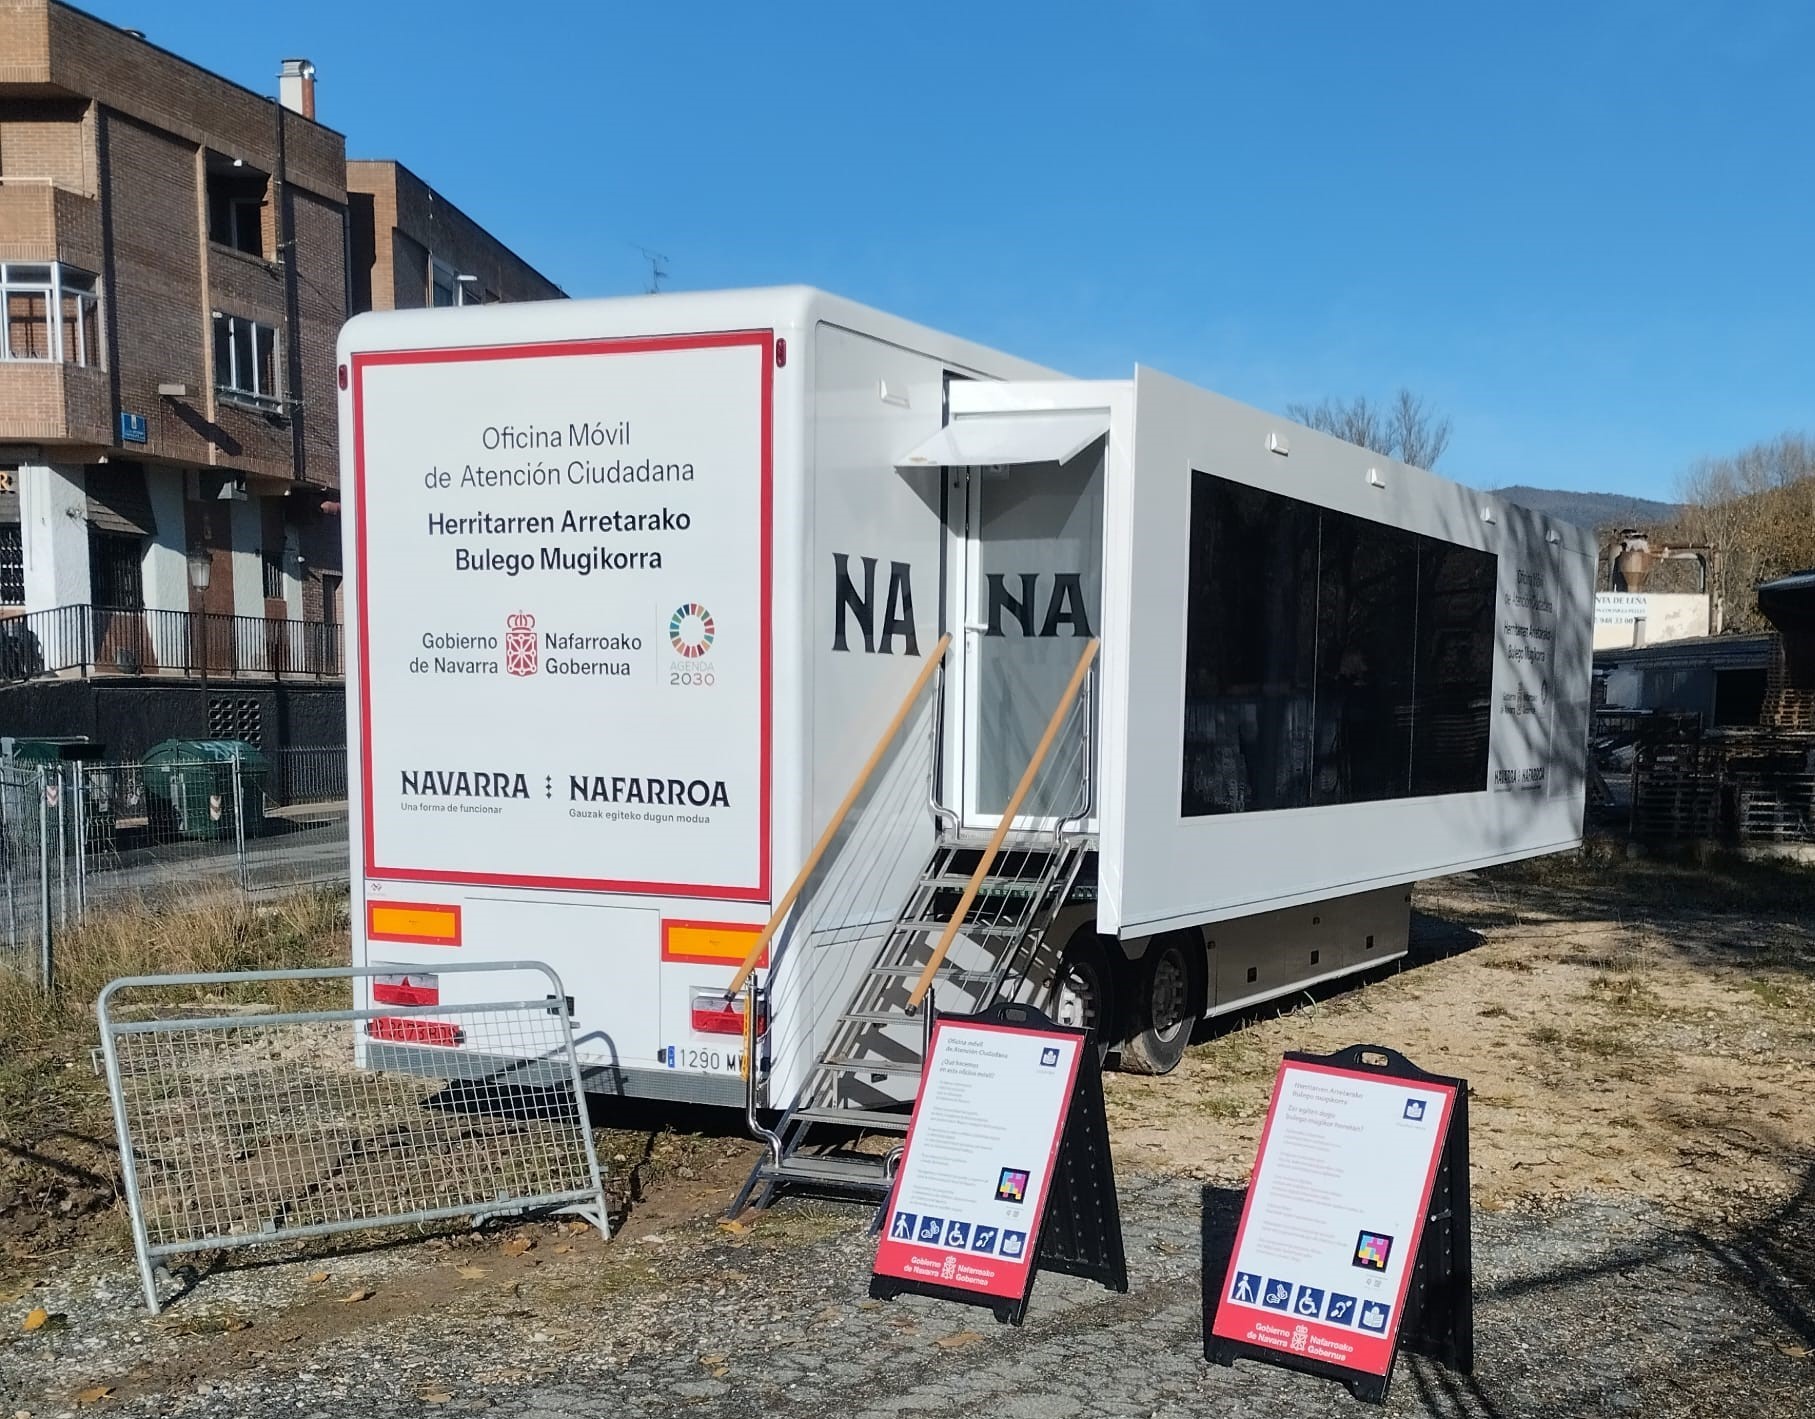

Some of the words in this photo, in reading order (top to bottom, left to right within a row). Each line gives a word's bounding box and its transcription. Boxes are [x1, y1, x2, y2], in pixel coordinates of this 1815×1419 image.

[483, 425, 563, 450] Oficina
[569, 421, 630, 448] Móvil
[424, 465, 452, 489] de
[460, 461, 561, 489] Atención
[567, 458, 695, 485] Ciudadana
[428, 511, 555, 536] Herritarren
[561, 507, 691, 533] Arretarako
[455, 548, 535, 576] Bulego
[540, 546, 663, 576] Mugikorra
[831, 552, 921, 658] NA
[984, 572, 1096, 638] NA
[422, 632, 498, 650] Gobierno
[545, 632, 642, 651] Nafarroako
[409, 656, 429, 674] de
[434, 657, 499, 675] Navarra
[545, 657, 631, 676] Gobernua
[670, 661, 715, 671] AGENDA
[670, 672, 715, 687] 2030
[400, 770, 531, 799] NAVARRA
[569, 775, 731, 808] NAFARROA
[401, 802, 418, 812] Una
[420, 802, 445, 812] forma
[447, 803, 458, 813] de
[459, 804, 503, 815] funcionar
[568, 808, 602, 819] Gauzak
[605, 810, 641, 822] egiteko
[643, 812, 674, 824] dugun
[676, 814, 710, 824] modua
[680, 1048, 719, 1070] 1290
[726, 1053, 744, 1072] M
[911, 1256, 941, 1268] Gobierno
[913, 1266, 939, 1277] Navarra
[1255, 1322, 1290, 1337] Gobierno
[1246, 1331, 1257, 1340] de
[1258, 1333, 1288, 1347] Navarra
[1309, 1335, 1354, 1353] Nafarroako
[1307, 1345, 1347, 1361] Gobernua
